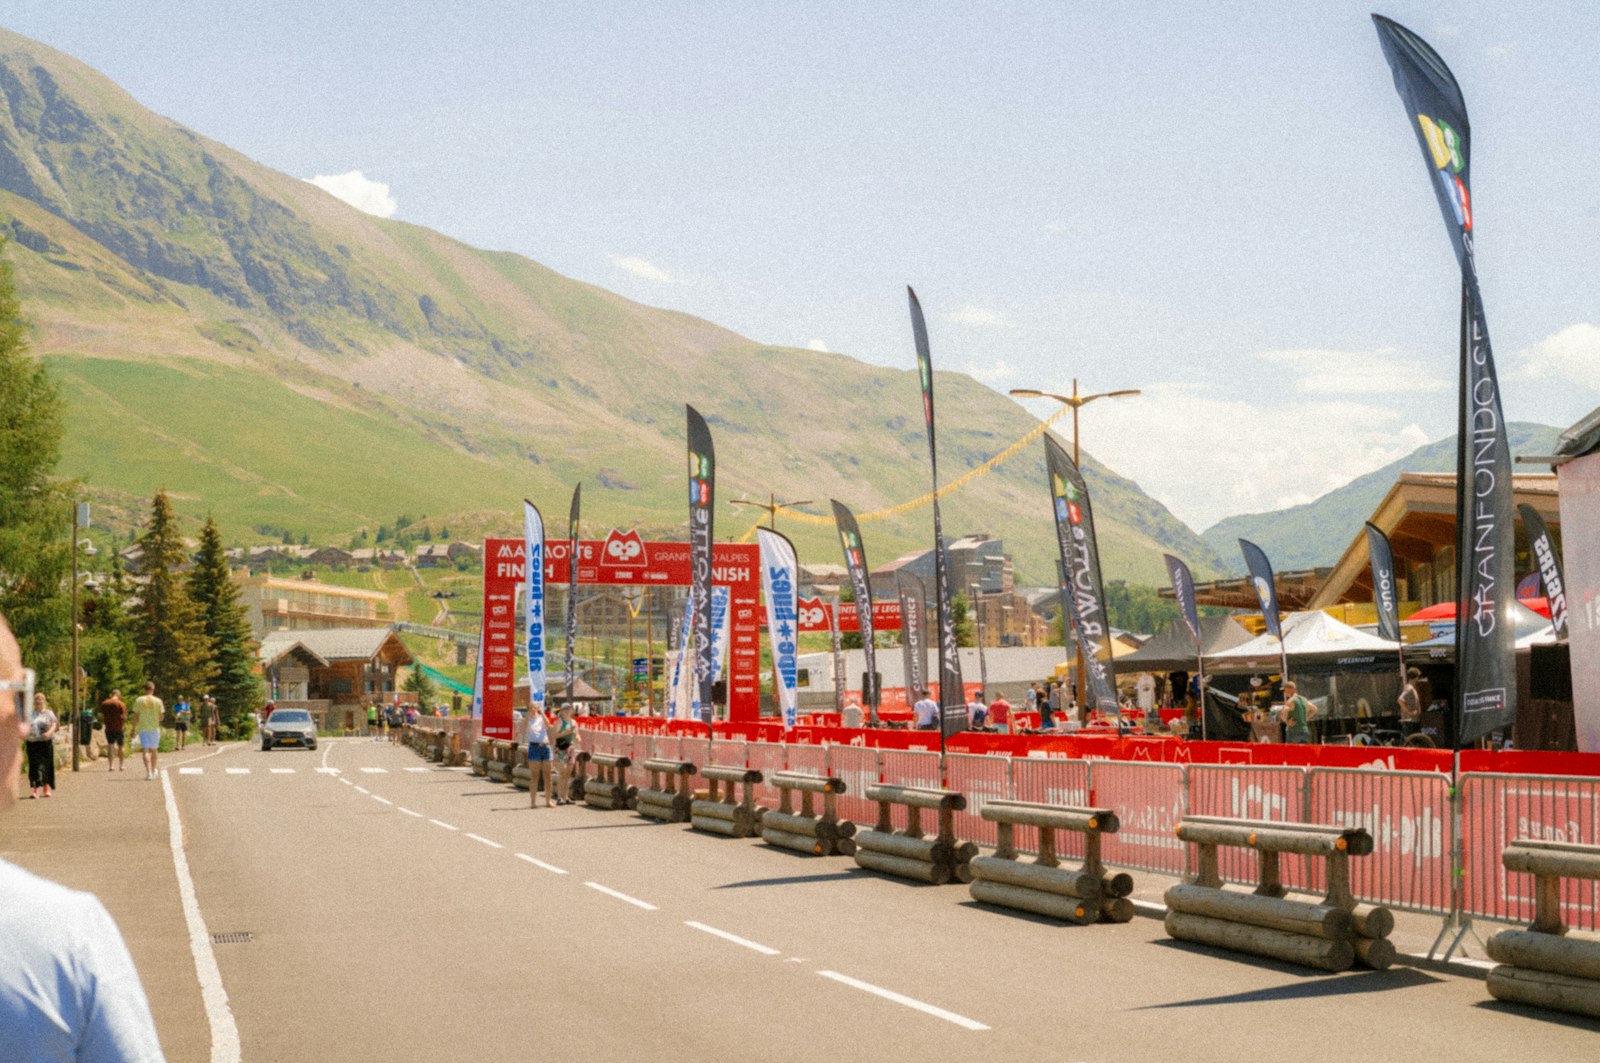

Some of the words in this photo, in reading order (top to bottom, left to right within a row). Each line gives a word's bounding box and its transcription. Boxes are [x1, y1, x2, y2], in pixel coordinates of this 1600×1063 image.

[1473, 378, 1498, 637] GRANFONDO
[716, 553, 750, 563] ALPES
[498, 563, 554, 578] FINH
[711, 567, 749, 581] NISH
